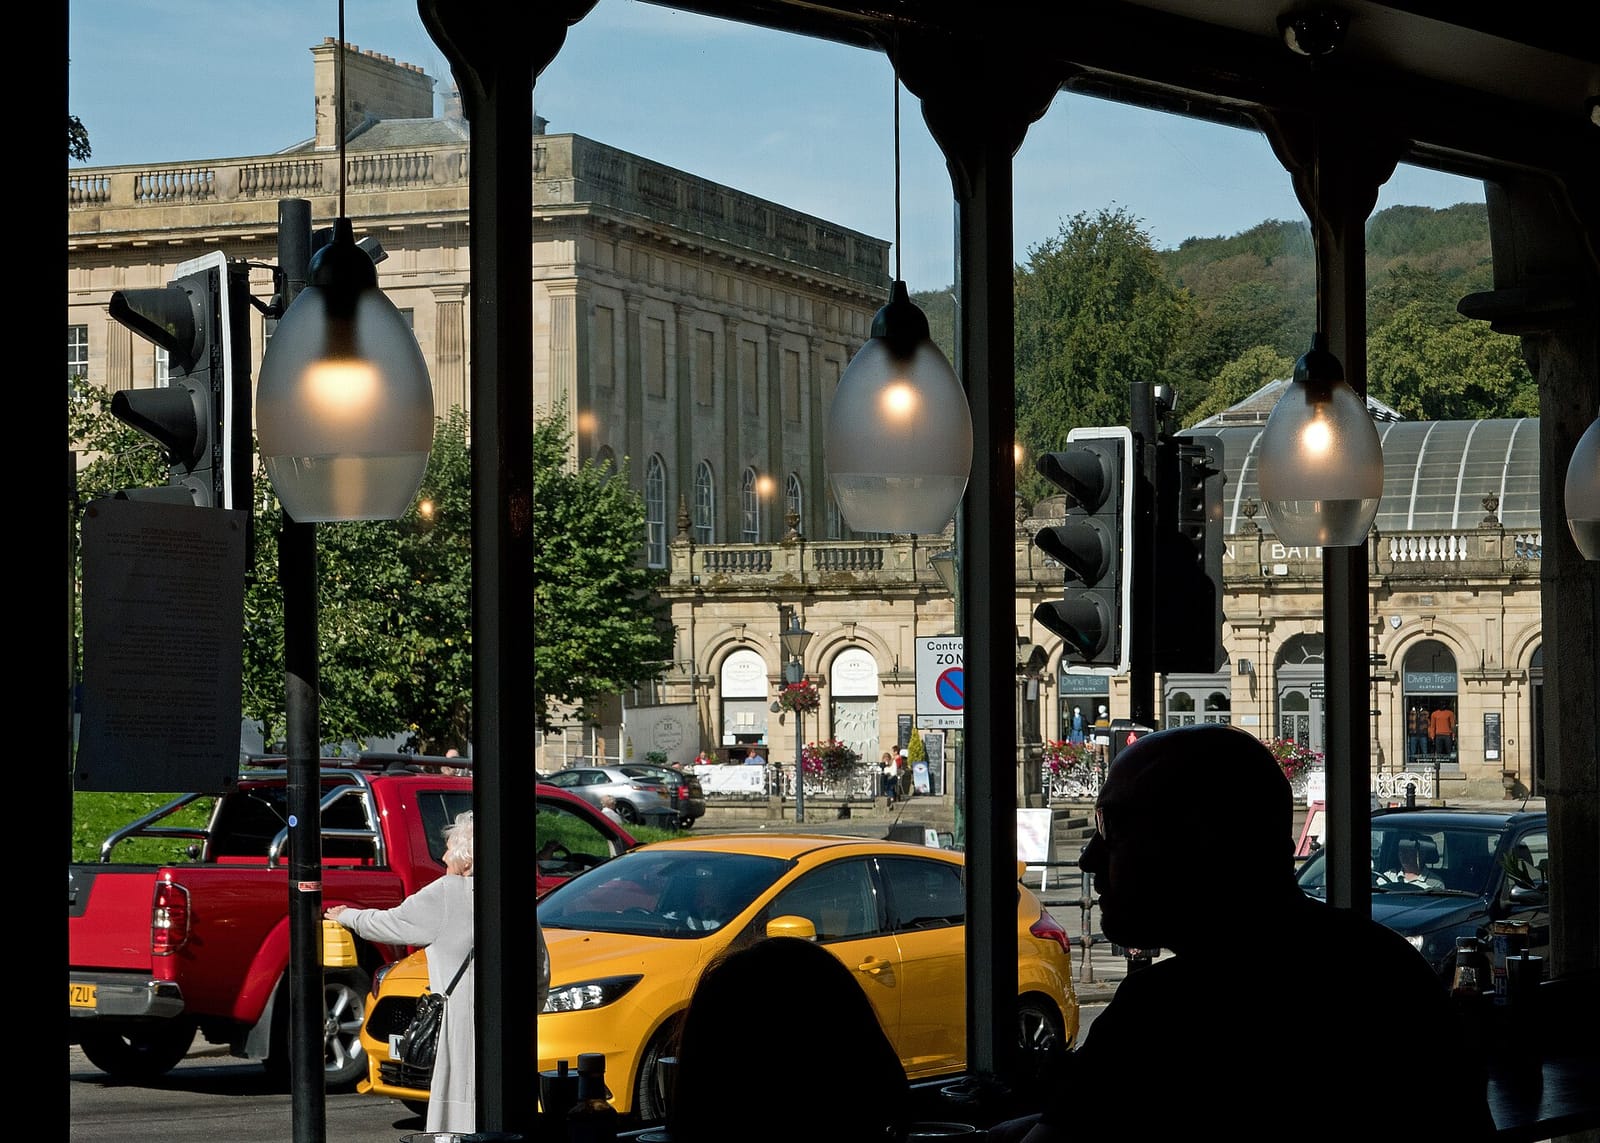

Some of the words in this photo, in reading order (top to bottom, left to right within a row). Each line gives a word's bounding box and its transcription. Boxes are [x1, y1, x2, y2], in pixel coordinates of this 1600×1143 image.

[927, 641, 963, 651] Contro
[936, 653, 963, 664] ZON
[1062, 676, 1084, 686] Divine
[1086, 676, 1107, 686] Trash
[1407, 673, 1431, 684] Divine
[1434, 673, 1455, 684] Trash
